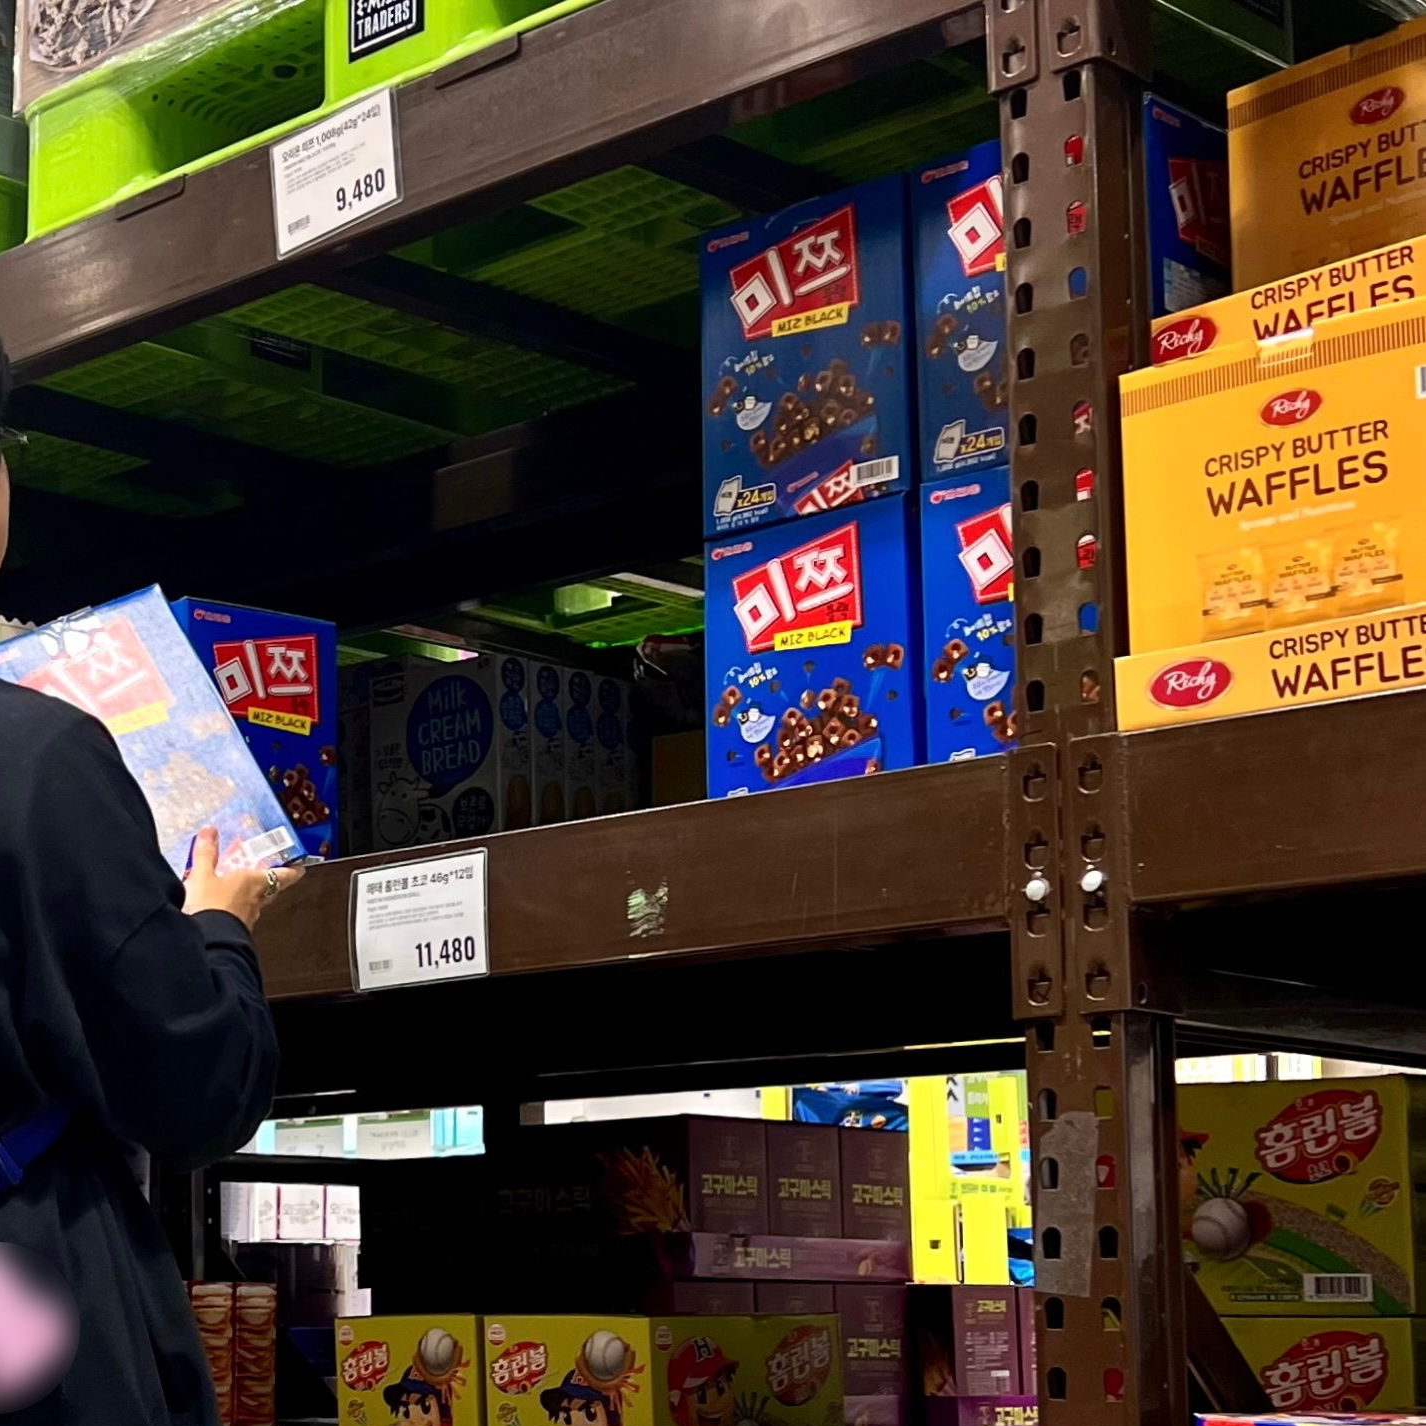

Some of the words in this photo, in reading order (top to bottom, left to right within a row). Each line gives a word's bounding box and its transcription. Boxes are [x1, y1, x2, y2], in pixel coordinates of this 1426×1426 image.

[356, 0, 411, 40] TRADERS
[1298, 138, 1372, 180] CRISPY
[336, 168, 385, 211] 9,480
[730, 228, 852, 329] 미쯔
[1251, 272, 1323, 310] CRISPY
[1329, 244, 1415, 287] BUTTER
[777, 317, 802, 334] MIZ
[804, 307, 845, 326] BLACK
[1253, 274, 1416, 341] WAFFLES
[1271, 390, 1312, 420] Richy
[1204, 440, 1286, 478] CRISPY
[1292, 419, 1389, 459] BUTTER
[1206, 450, 1389, 518] WAFFLES
[733, 544, 854, 641] 미쯔
[780, 632, 805, 647] MIZ
[807, 625, 847, 644] BLACK
[1269, 627, 1350, 660] CRISPY
[214, 639, 313, 703] 미쯔
[1164, 661, 1217, 700] Richy
[1271, 643, 1426, 698] WAFFLE
[428, 681, 467, 711] Milk
[252, 711, 274, 723] MIZ
[276, 714, 307, 731] BLACK
[417, 715, 481, 746] CREAM
[421, 741, 481, 775] BREAD
[385, 877, 409, 893] 홈런볼
[410, 874, 428, 888] 초코
[415, 935, 476, 970] 11,480
[1258, 1093, 1380, 1169] 홈런볼
[701, 1174, 758, 1196] 고구마스틱
[778, 1178, 832, 1201] 고구마스틱
[851, 1184, 904, 1207] 고구마스틱
[734, 1247, 793, 1270] 고구마스틱
[341, 1343, 389, 1384] 홈런볼
[491, 1344, 549, 1386] 홈런볼
[768, 1331, 833, 1391] 홈런볼
[846, 1337, 902, 1359] 고구마스틱
[1266, 1338, 1385, 1408] 홈런볼
